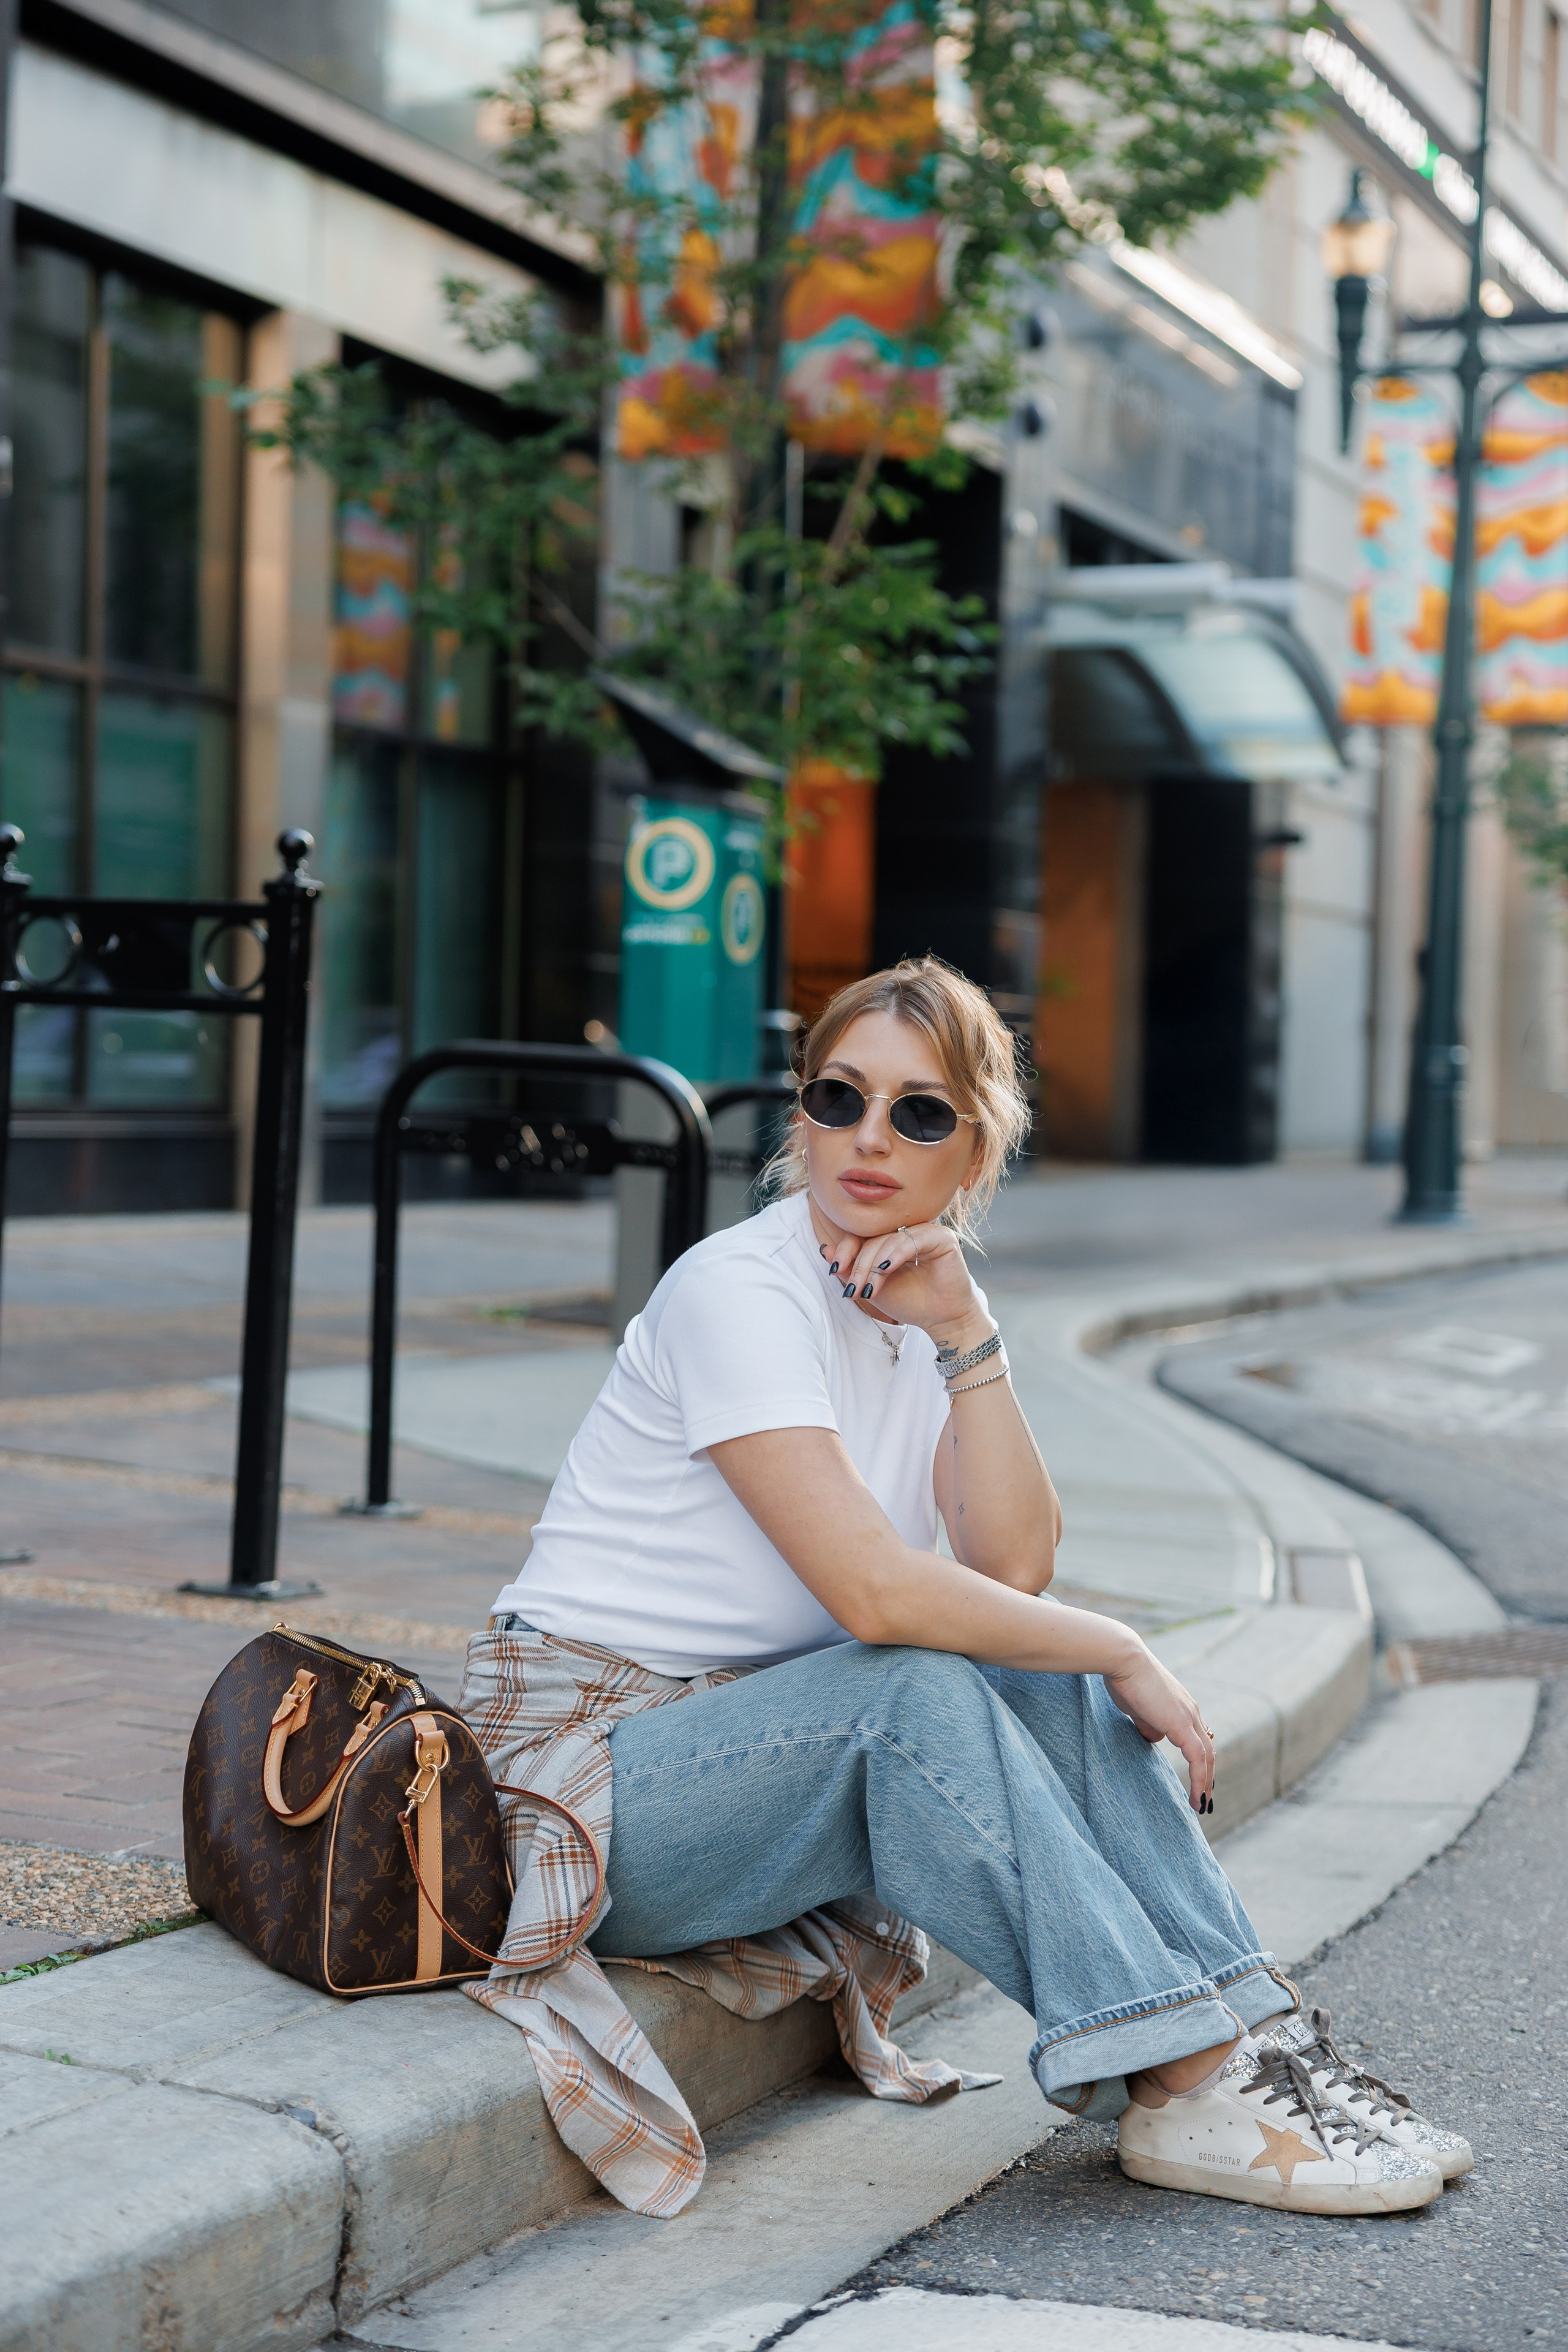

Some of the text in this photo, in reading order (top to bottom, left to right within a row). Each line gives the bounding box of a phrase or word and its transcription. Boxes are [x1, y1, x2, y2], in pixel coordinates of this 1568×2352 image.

[652, 838, 693, 885] P
[369, 1844, 398, 1879] LV
[462, 1833, 488, 1868] LV
[368, 1946, 396, 1980] LV
[1199, 2152, 1240, 2166] GGDB/SSTAR
